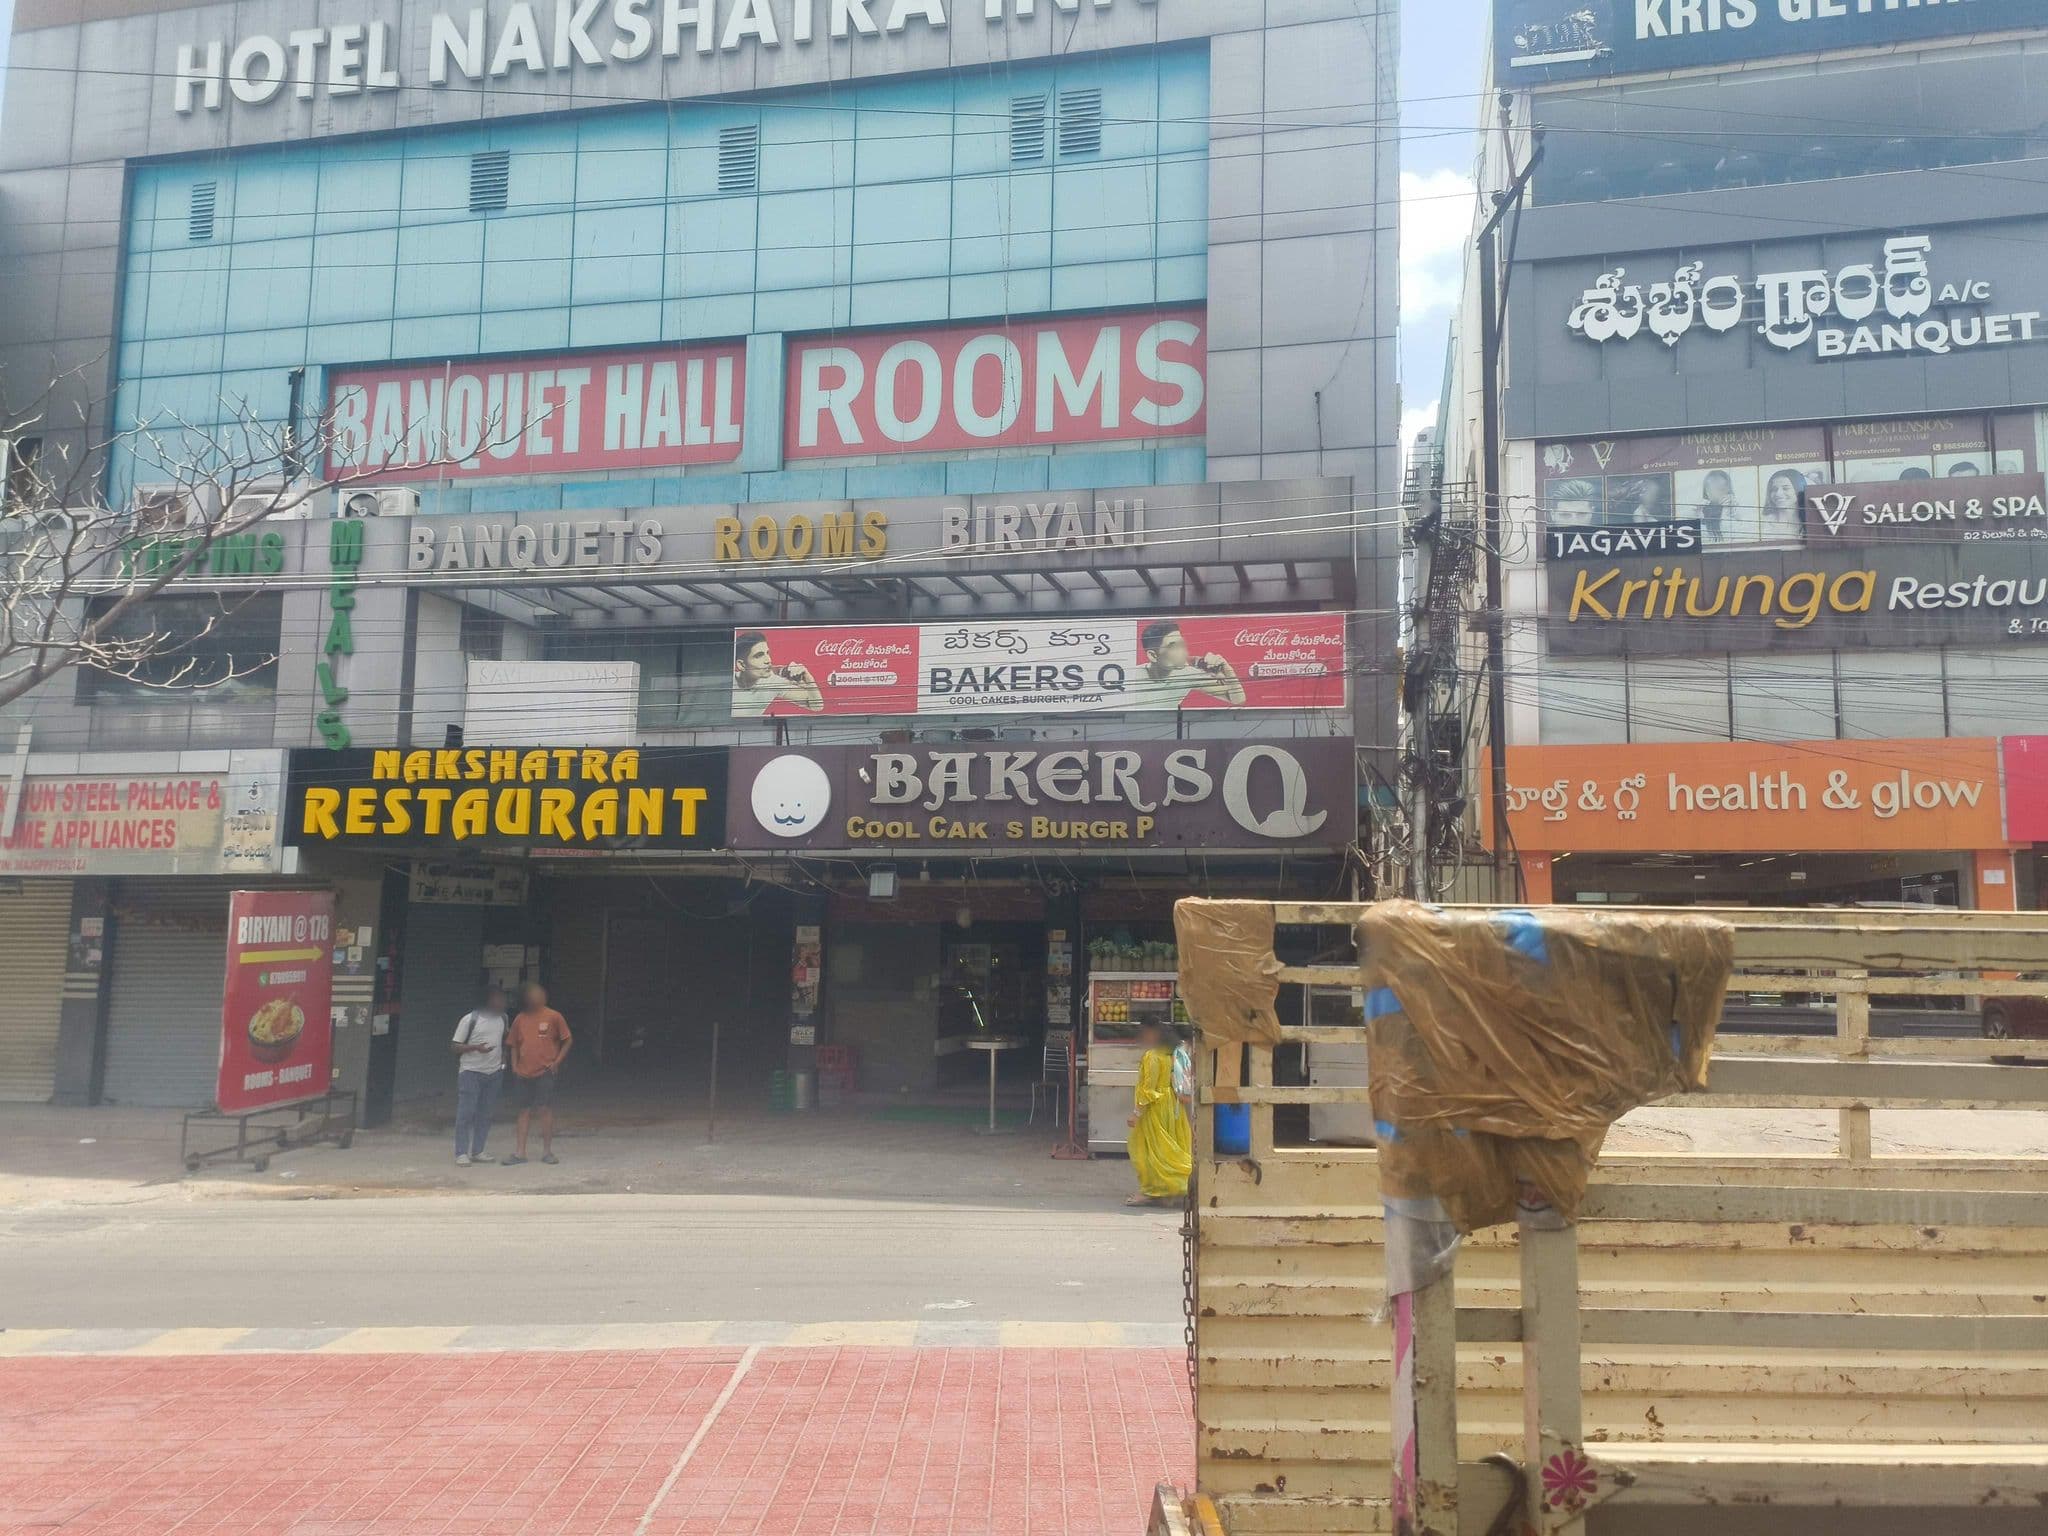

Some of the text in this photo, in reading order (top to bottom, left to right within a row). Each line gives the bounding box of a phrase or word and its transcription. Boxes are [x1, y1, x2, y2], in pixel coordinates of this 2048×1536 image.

[175, 19, 399, 114] HOTEL
[1567, 260, 1746, 347] శుభం
[1938, 279, 1991, 303] A/C
[1818, 311, 2041, 357] BANQUET
[800, 320, 1205, 447] ROOMS
[331, 355, 740, 470] BANQUET HALL
[1871, 418, 1954, 435] EXTENSIONS
[1724, 428, 1778, 442] BEAUTY
[1729, 440, 1763, 453] SALON
[1863, 499, 1956, 525] SALON
[1965, 498, 1983, 519] &
[1992, 495, 2046, 517] SPA
[408, 498, 1145, 570] BANQUETS ROOMS BIRYANI
[1554, 525, 1695, 558] JAGAVI'S
[1568, 566, 1878, 629] Kritunga
[1888, 574, 2047, 611] Restau
[316, 518, 364, 752] MEALS
[2008, 618, 2023, 634] &
[930, 663, 1126, 693] BAKERS Q
[949, 696, 980, 706] COOL
[1072, 694, 1104, 703] PIZZA
[372, 749, 640, 784] NAKSHATRA
[62, 782, 121, 812] STEEL
[128, 780, 201, 811] PALACE
[207, 779, 222, 810] &
[870, 744, 1328, 839] BAKERS Q
[1577, 780, 1607, 811] &
[1668, 769, 1807, 812] health
[1822, 769, 1862, 811] &
[1872, 769, 1984, 818] glow
[303, 786, 708, 842] RESTAURANT
[846, 816, 921, 839] COOL
[928, 816, 988, 839] CAK
[1031, 816, 1129, 839] BURGR
[1137, 816, 1155, 839] P
[52, 818, 177, 850] APPLIANCES
[237, 915, 292, 945] BIRYANI
[294, 914, 308, 943] @
